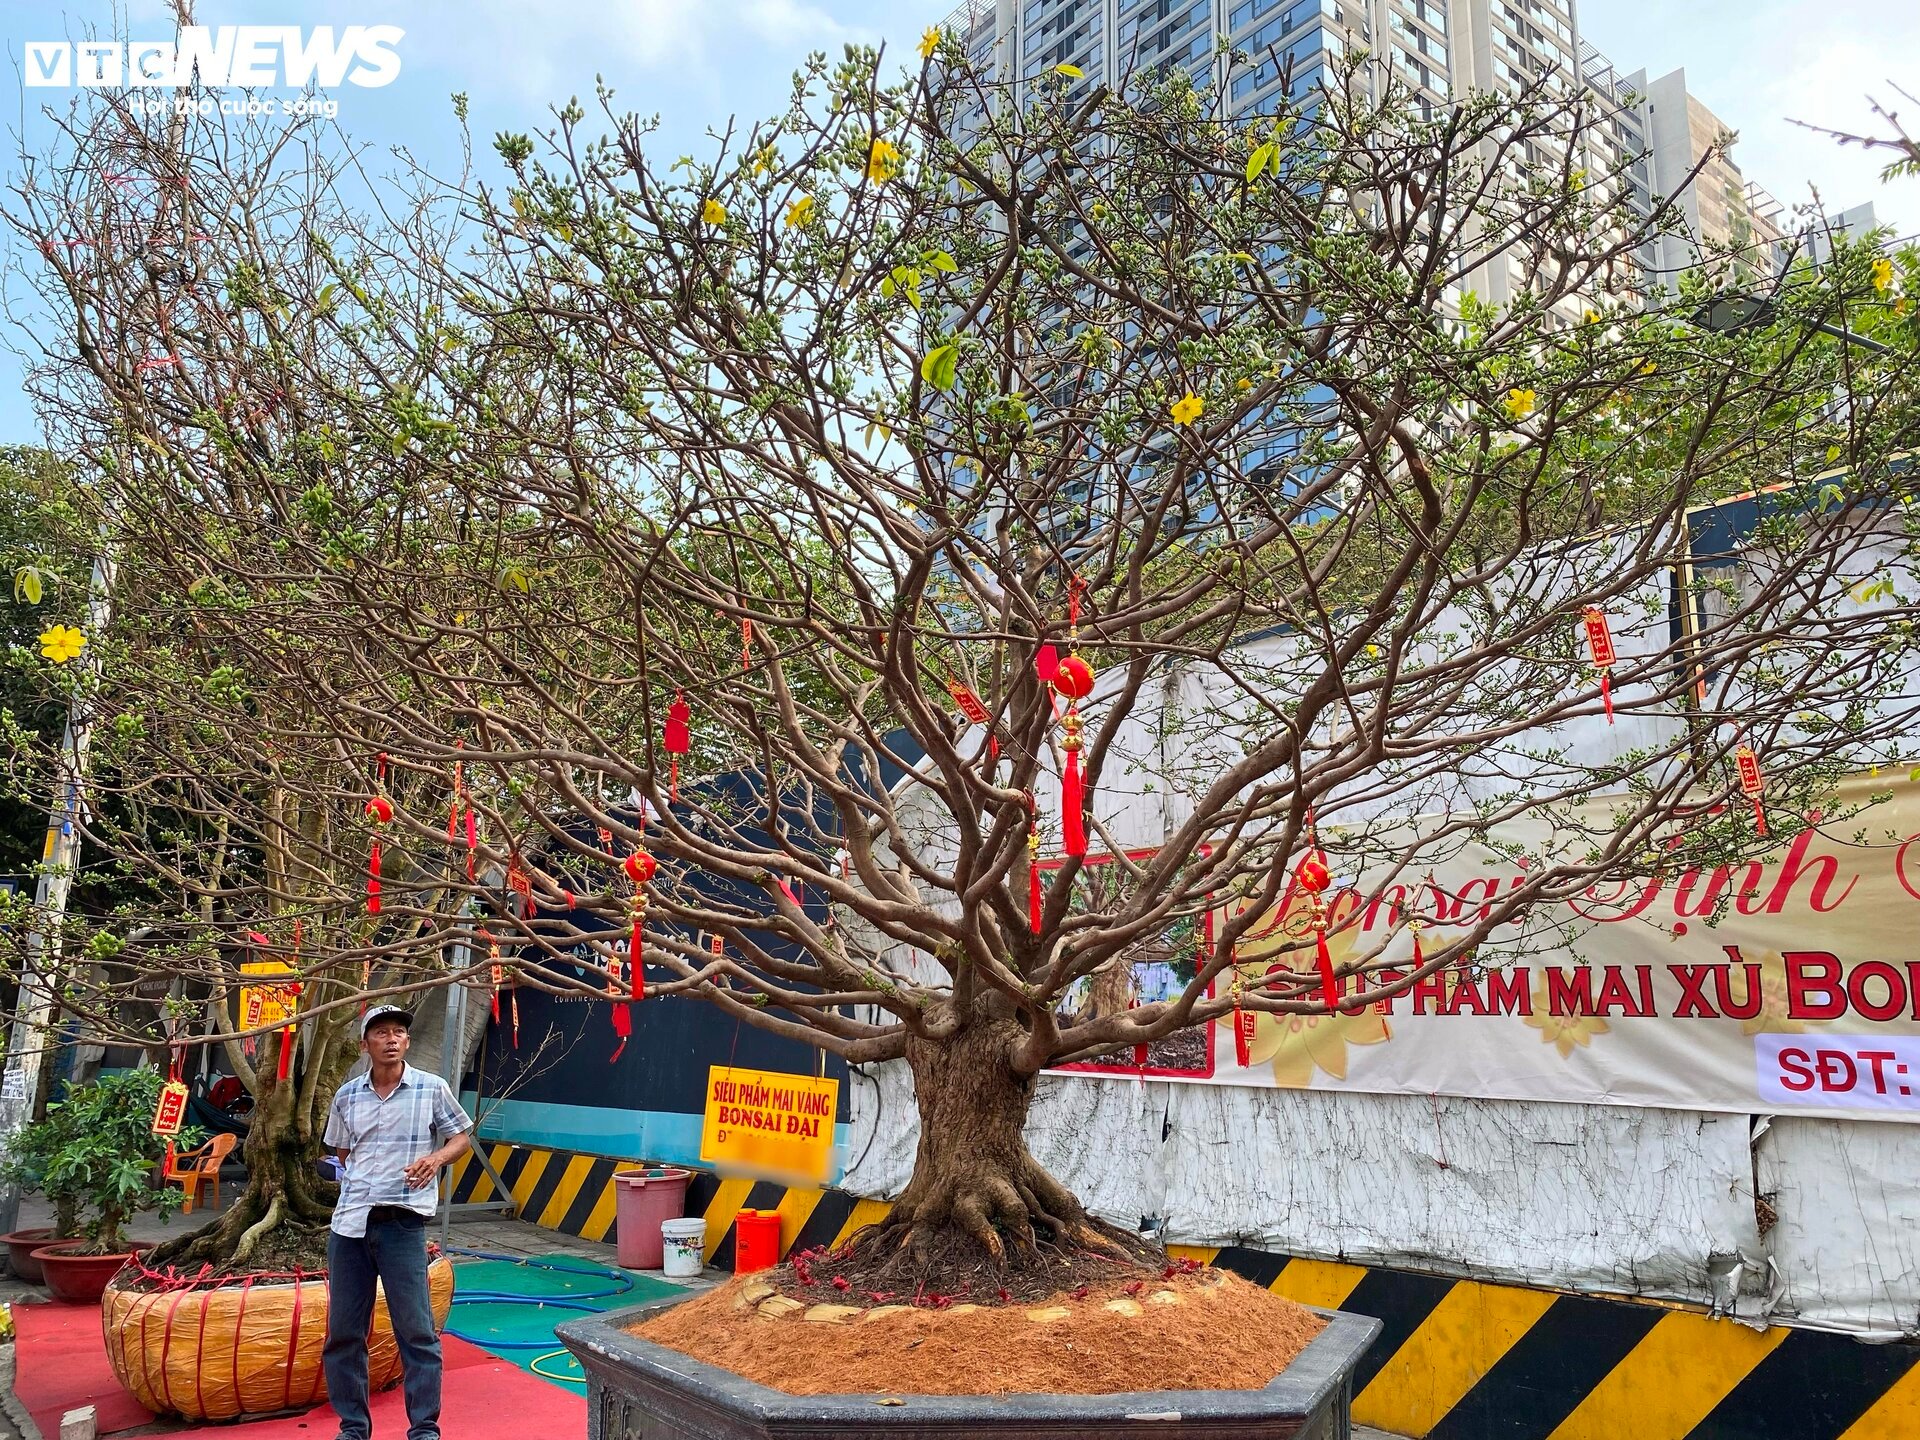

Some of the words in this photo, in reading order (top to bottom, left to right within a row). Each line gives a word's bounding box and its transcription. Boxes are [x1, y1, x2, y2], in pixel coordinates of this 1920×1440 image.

[1545, 965, 1659, 1018] MAI
[1781, 951, 1920, 1022] BO
[1777, 1047, 1912, 1096] SĐT:
[714, 1077, 737, 1103] SIÊU
[739, 1076, 770, 1108] PHẨM
[772, 1088, 795, 1112] MAI
[797, 1087, 830, 1117] VÀNG
[718, 1106, 782, 1133] BONSAI
[786, 1115, 820, 1142] ĐẠI
